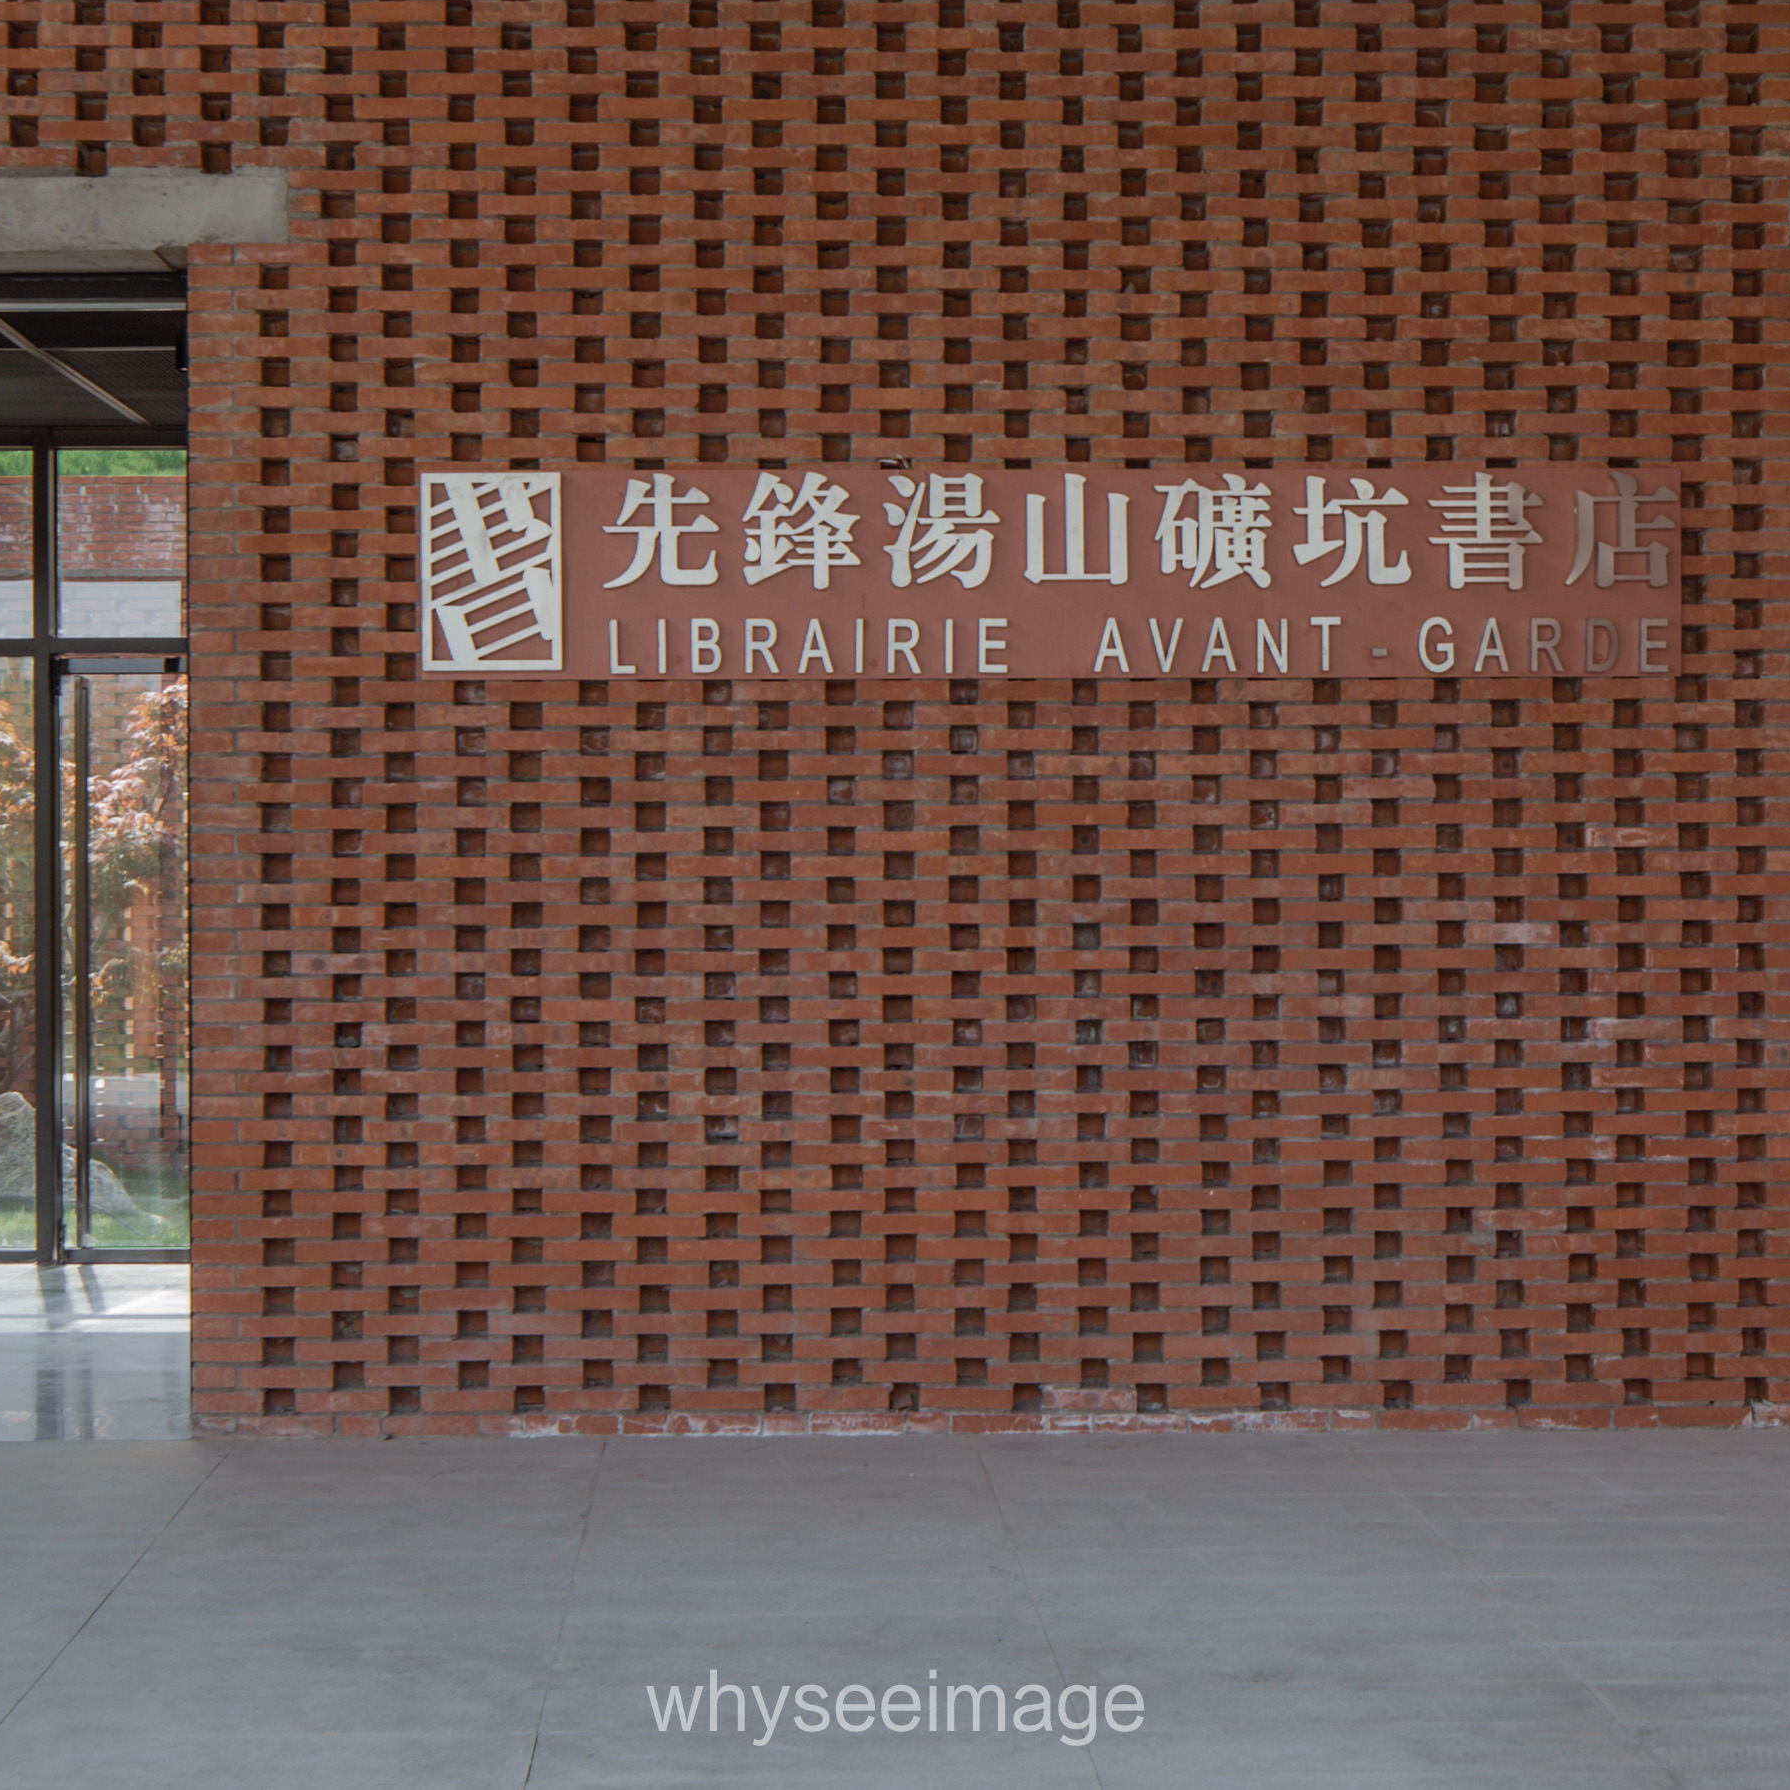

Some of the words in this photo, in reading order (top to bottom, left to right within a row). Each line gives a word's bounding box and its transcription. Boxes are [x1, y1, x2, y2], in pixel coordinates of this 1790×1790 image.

[601, 471, 1680, 591] 先鋒湯山礦坑書店
[609, 617, 1009, 675] LIBRAIRIE
